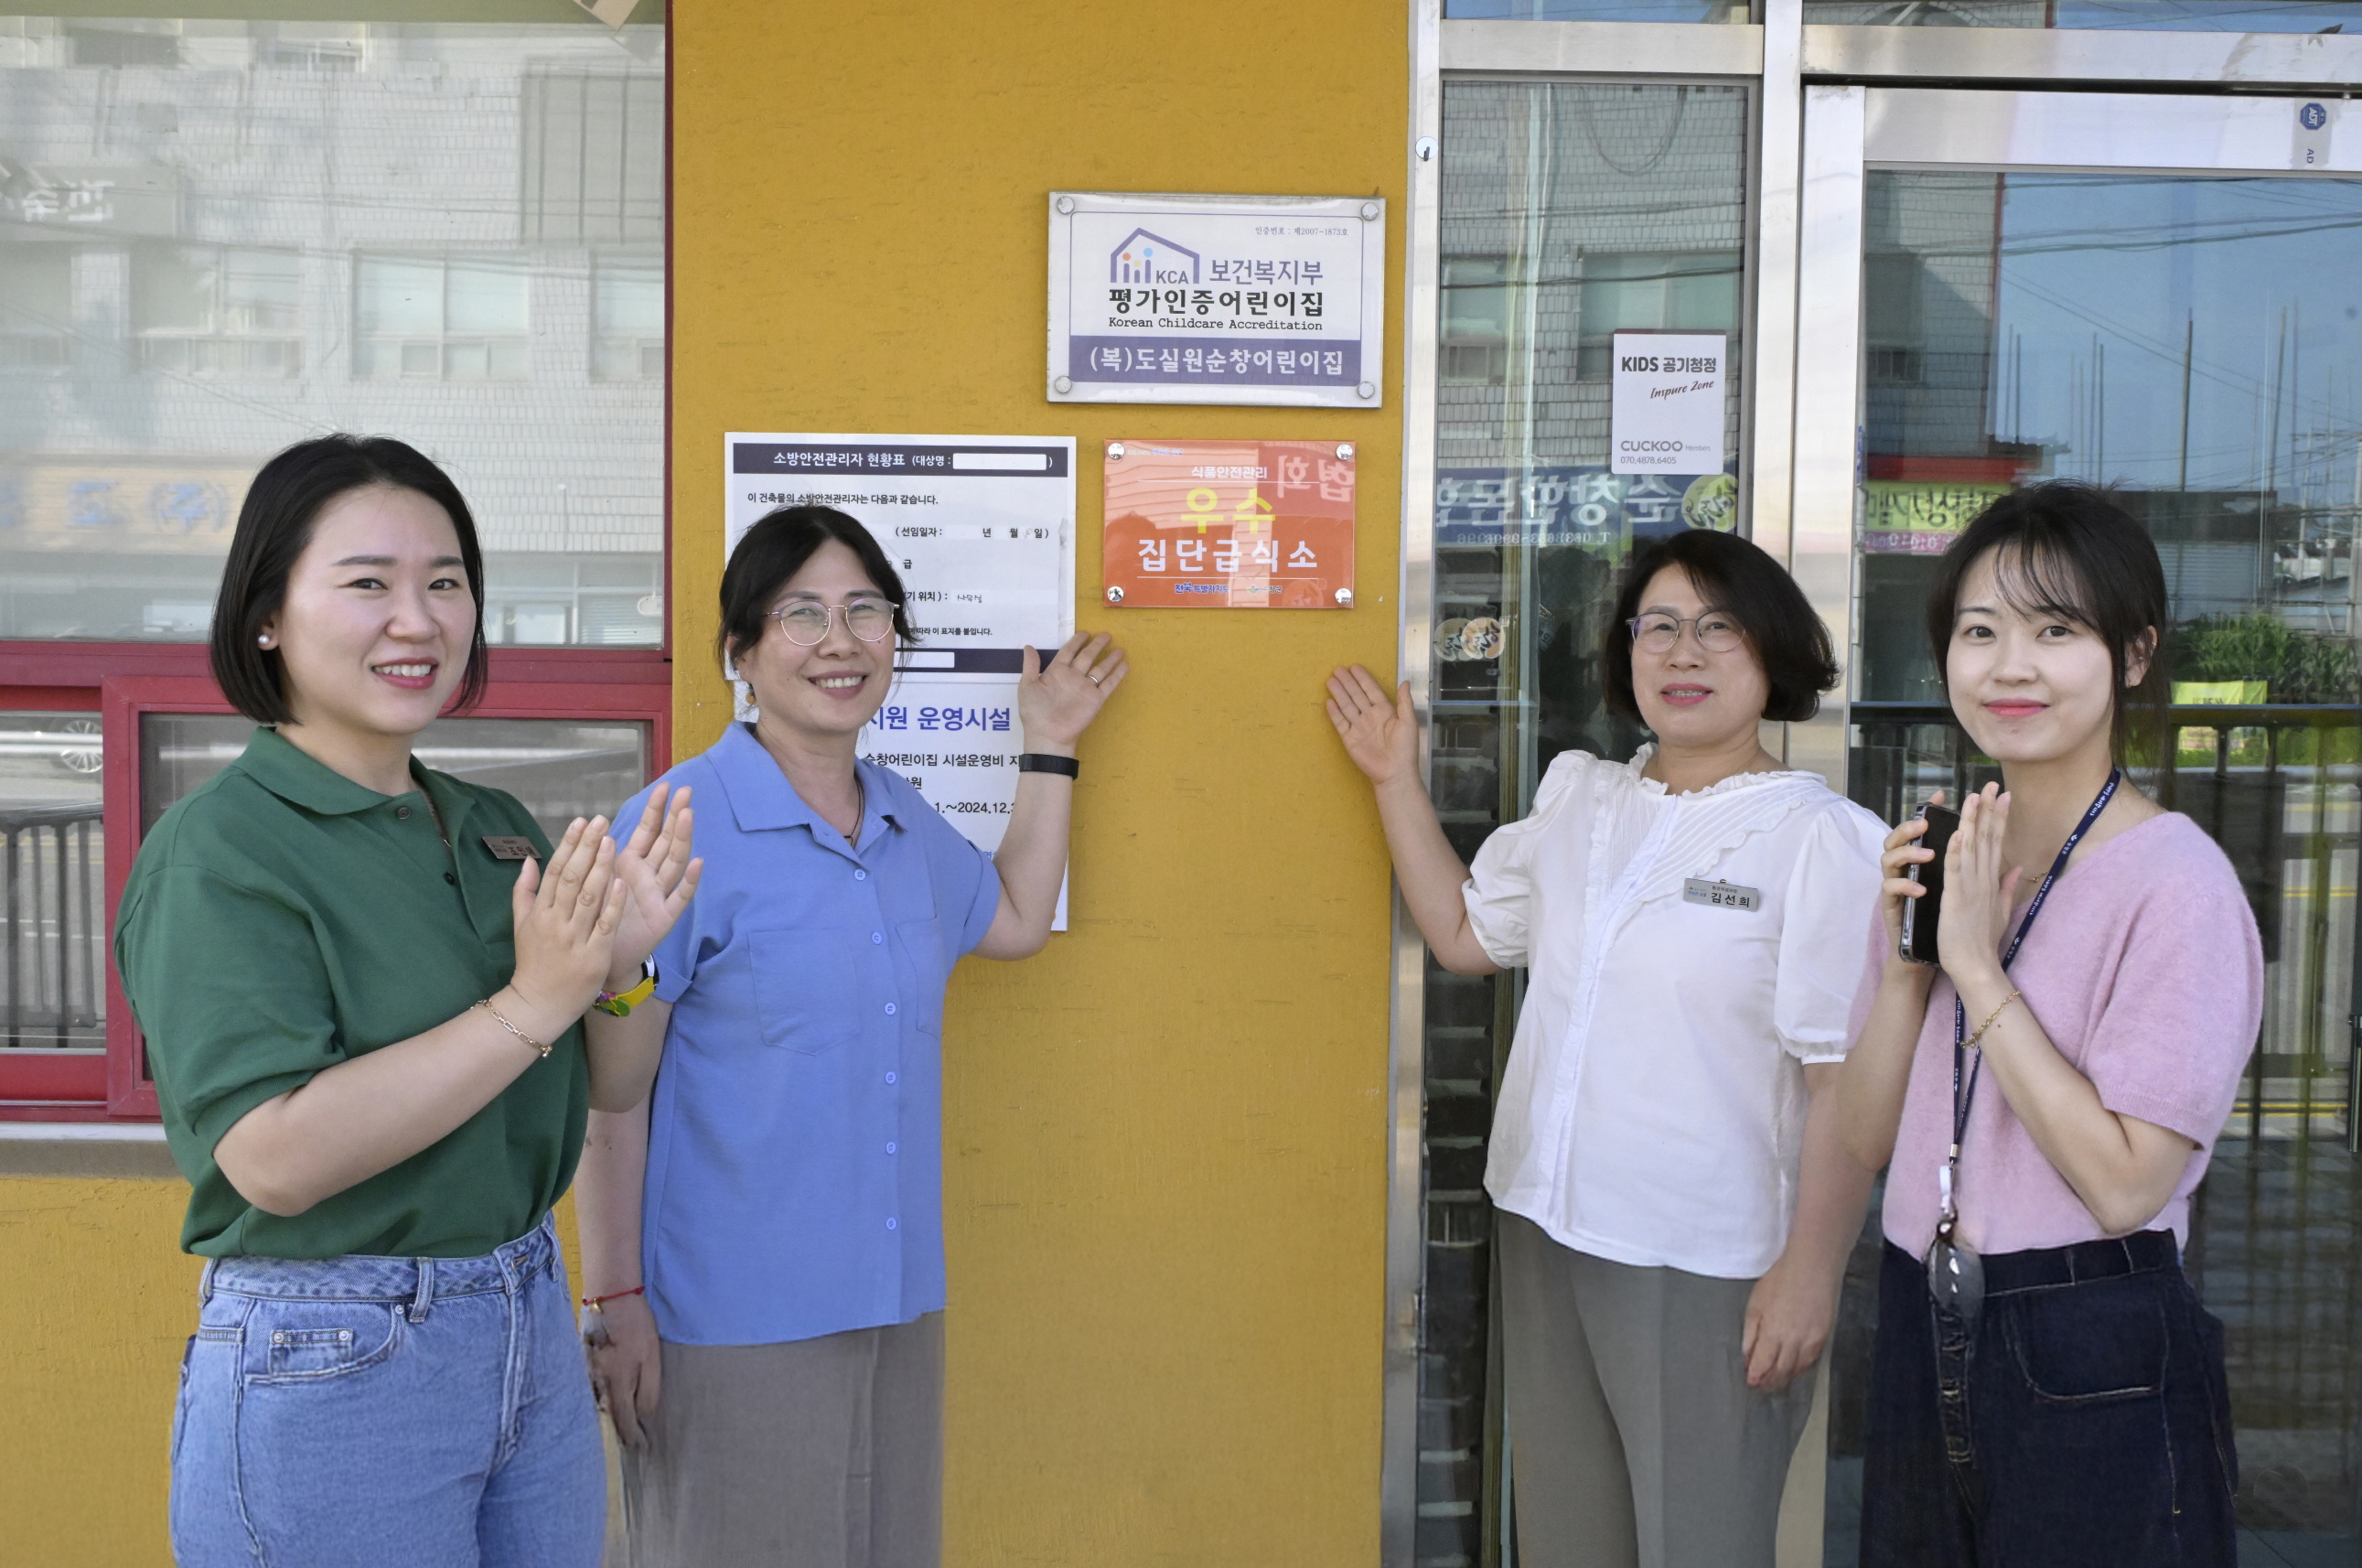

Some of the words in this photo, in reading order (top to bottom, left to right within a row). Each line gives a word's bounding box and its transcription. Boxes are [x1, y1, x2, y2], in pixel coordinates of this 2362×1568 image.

[2308, 106, 2317, 126] ADT
[1255, 226, 1286, 236] 인증번호
[1155, 269, 1189, 285] KCA
[1208, 259, 1324, 286] 보건복지부
[1109, 288, 1324, 317] 평가인증어린이집
[1108, 317, 1154, 328] Korean
[1158, 317, 1224, 329] Childcare
[1229, 319, 1323, 331] Accreditation
[1090, 347, 1344, 376] (복)도실원순창어린이집
[1621, 356, 1659, 372] KIDS
[1662, 357, 1717, 373] 공기청정
[1649, 387, 1688, 401] Inspure
[1691, 380, 1714, 392] Zone
[1620, 440, 1683, 452] CUCKOO
[773, 452, 864, 467] 소방안전관리자
[866, 453, 906, 468] 현황표
[1620, 456, 1677, 465] 070.4878.6405
[1191, 465, 1269, 479] 식품안전관리
[747, 493, 757, 503] 이
[758, 493, 795, 504] 건축물의
[797, 494, 869, 505] 소방안전관리자는
[870, 494, 898, 505] 다음과
[900, 495, 939, 506] 같습니다.
[1180, 488, 1276, 534] 우수
[982, 527, 992, 538] 년
[1009, 528, 1019, 539] 월
[1137, 539, 1318, 573] 집단급식소
[903, 559, 913, 570] 급
[918, 591, 937, 602] 위치
[1261, 585, 1283, 595] 순창군
[932, 628, 939, 636] 이
[940, 628, 961, 636] 표지를
[917, 707, 1011, 731] 운영시설
[942, 754, 1004, 768] 시설운영비
